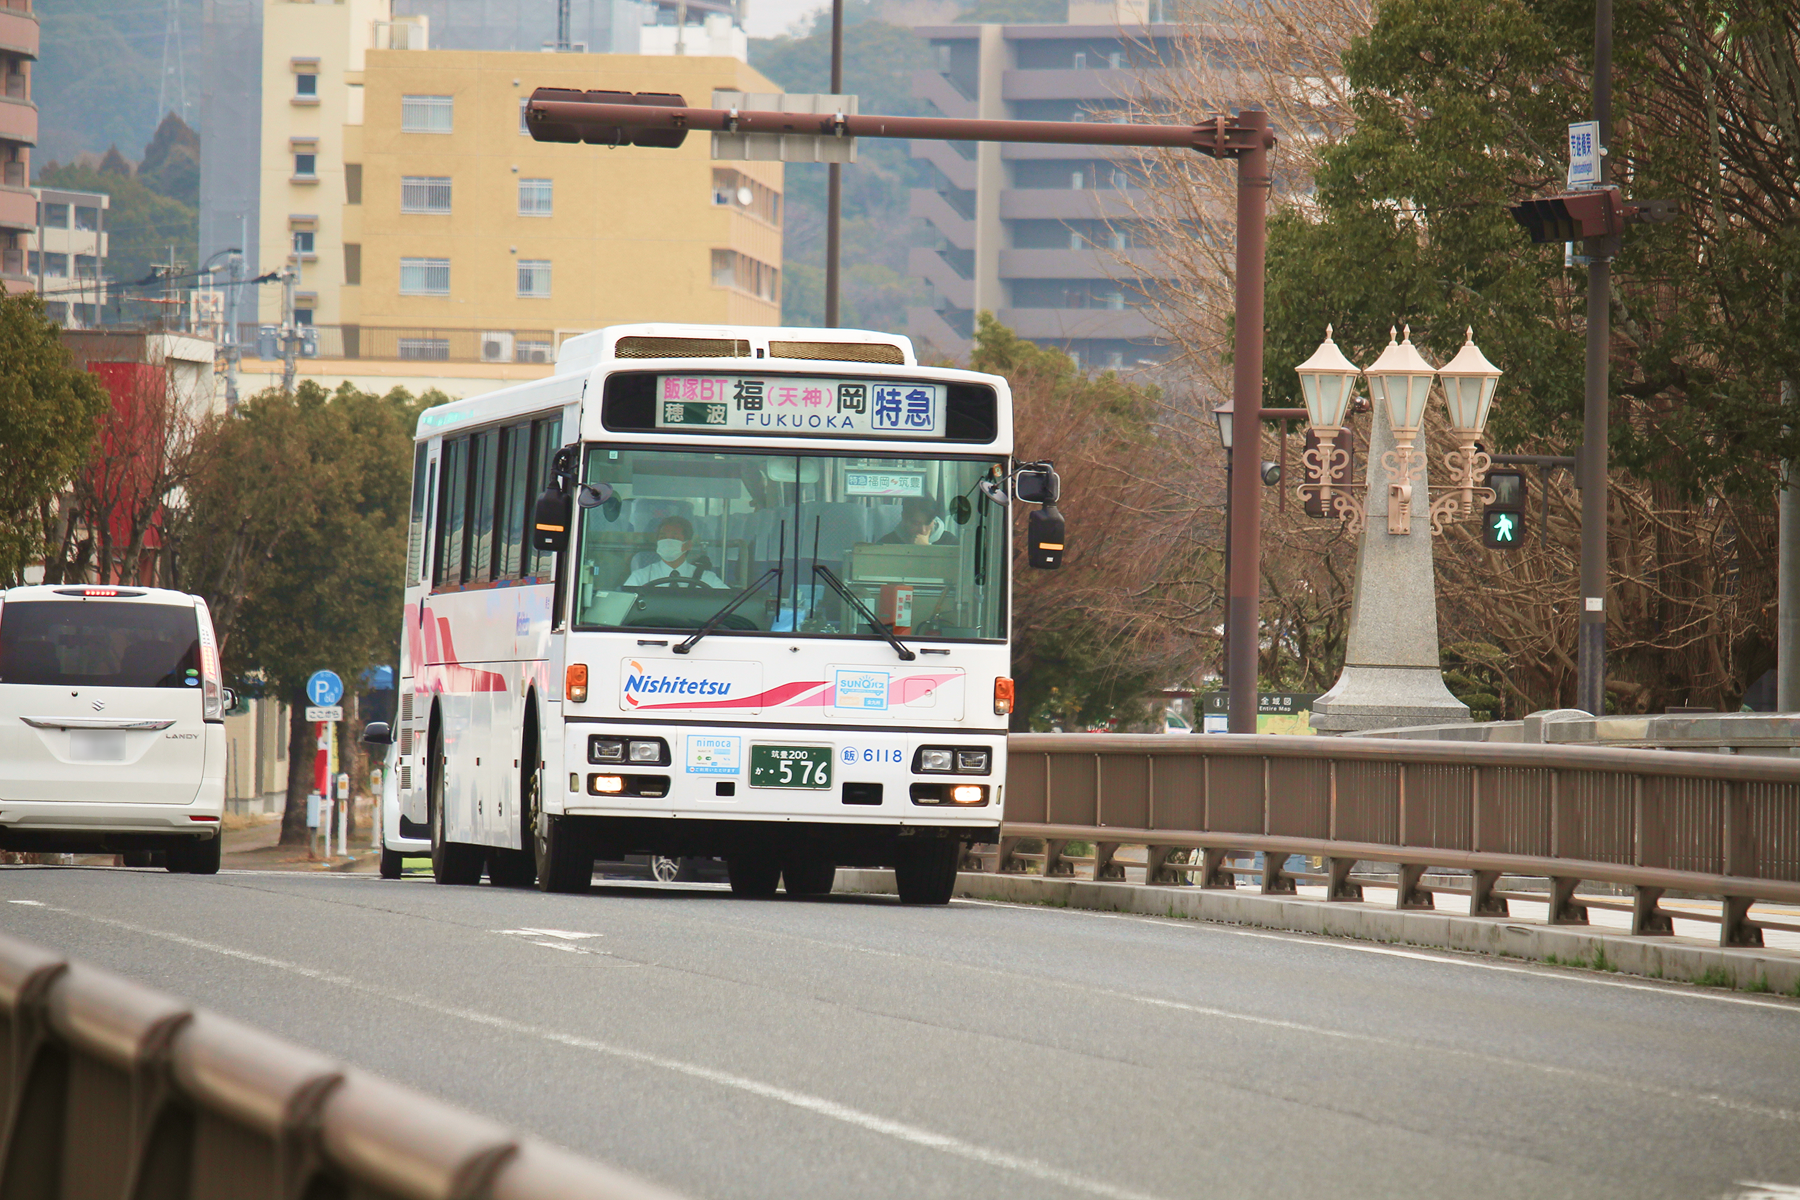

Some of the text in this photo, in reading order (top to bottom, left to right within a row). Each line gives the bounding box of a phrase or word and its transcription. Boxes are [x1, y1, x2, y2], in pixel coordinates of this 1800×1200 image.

[663, 377, 729, 401] 飯塚BT
[875, 388, 931, 427] 特急
[745, 413, 854, 429] FUKUOKA
[868, 476, 890, 487] 福岡
[315, 680, 330, 703] P
[623, 674, 732, 696] Nishitetsu
[1260, 696, 1292, 706] 全域図
[696, 737, 731, 748] nimoca
[863, 748, 902, 763] 6118
